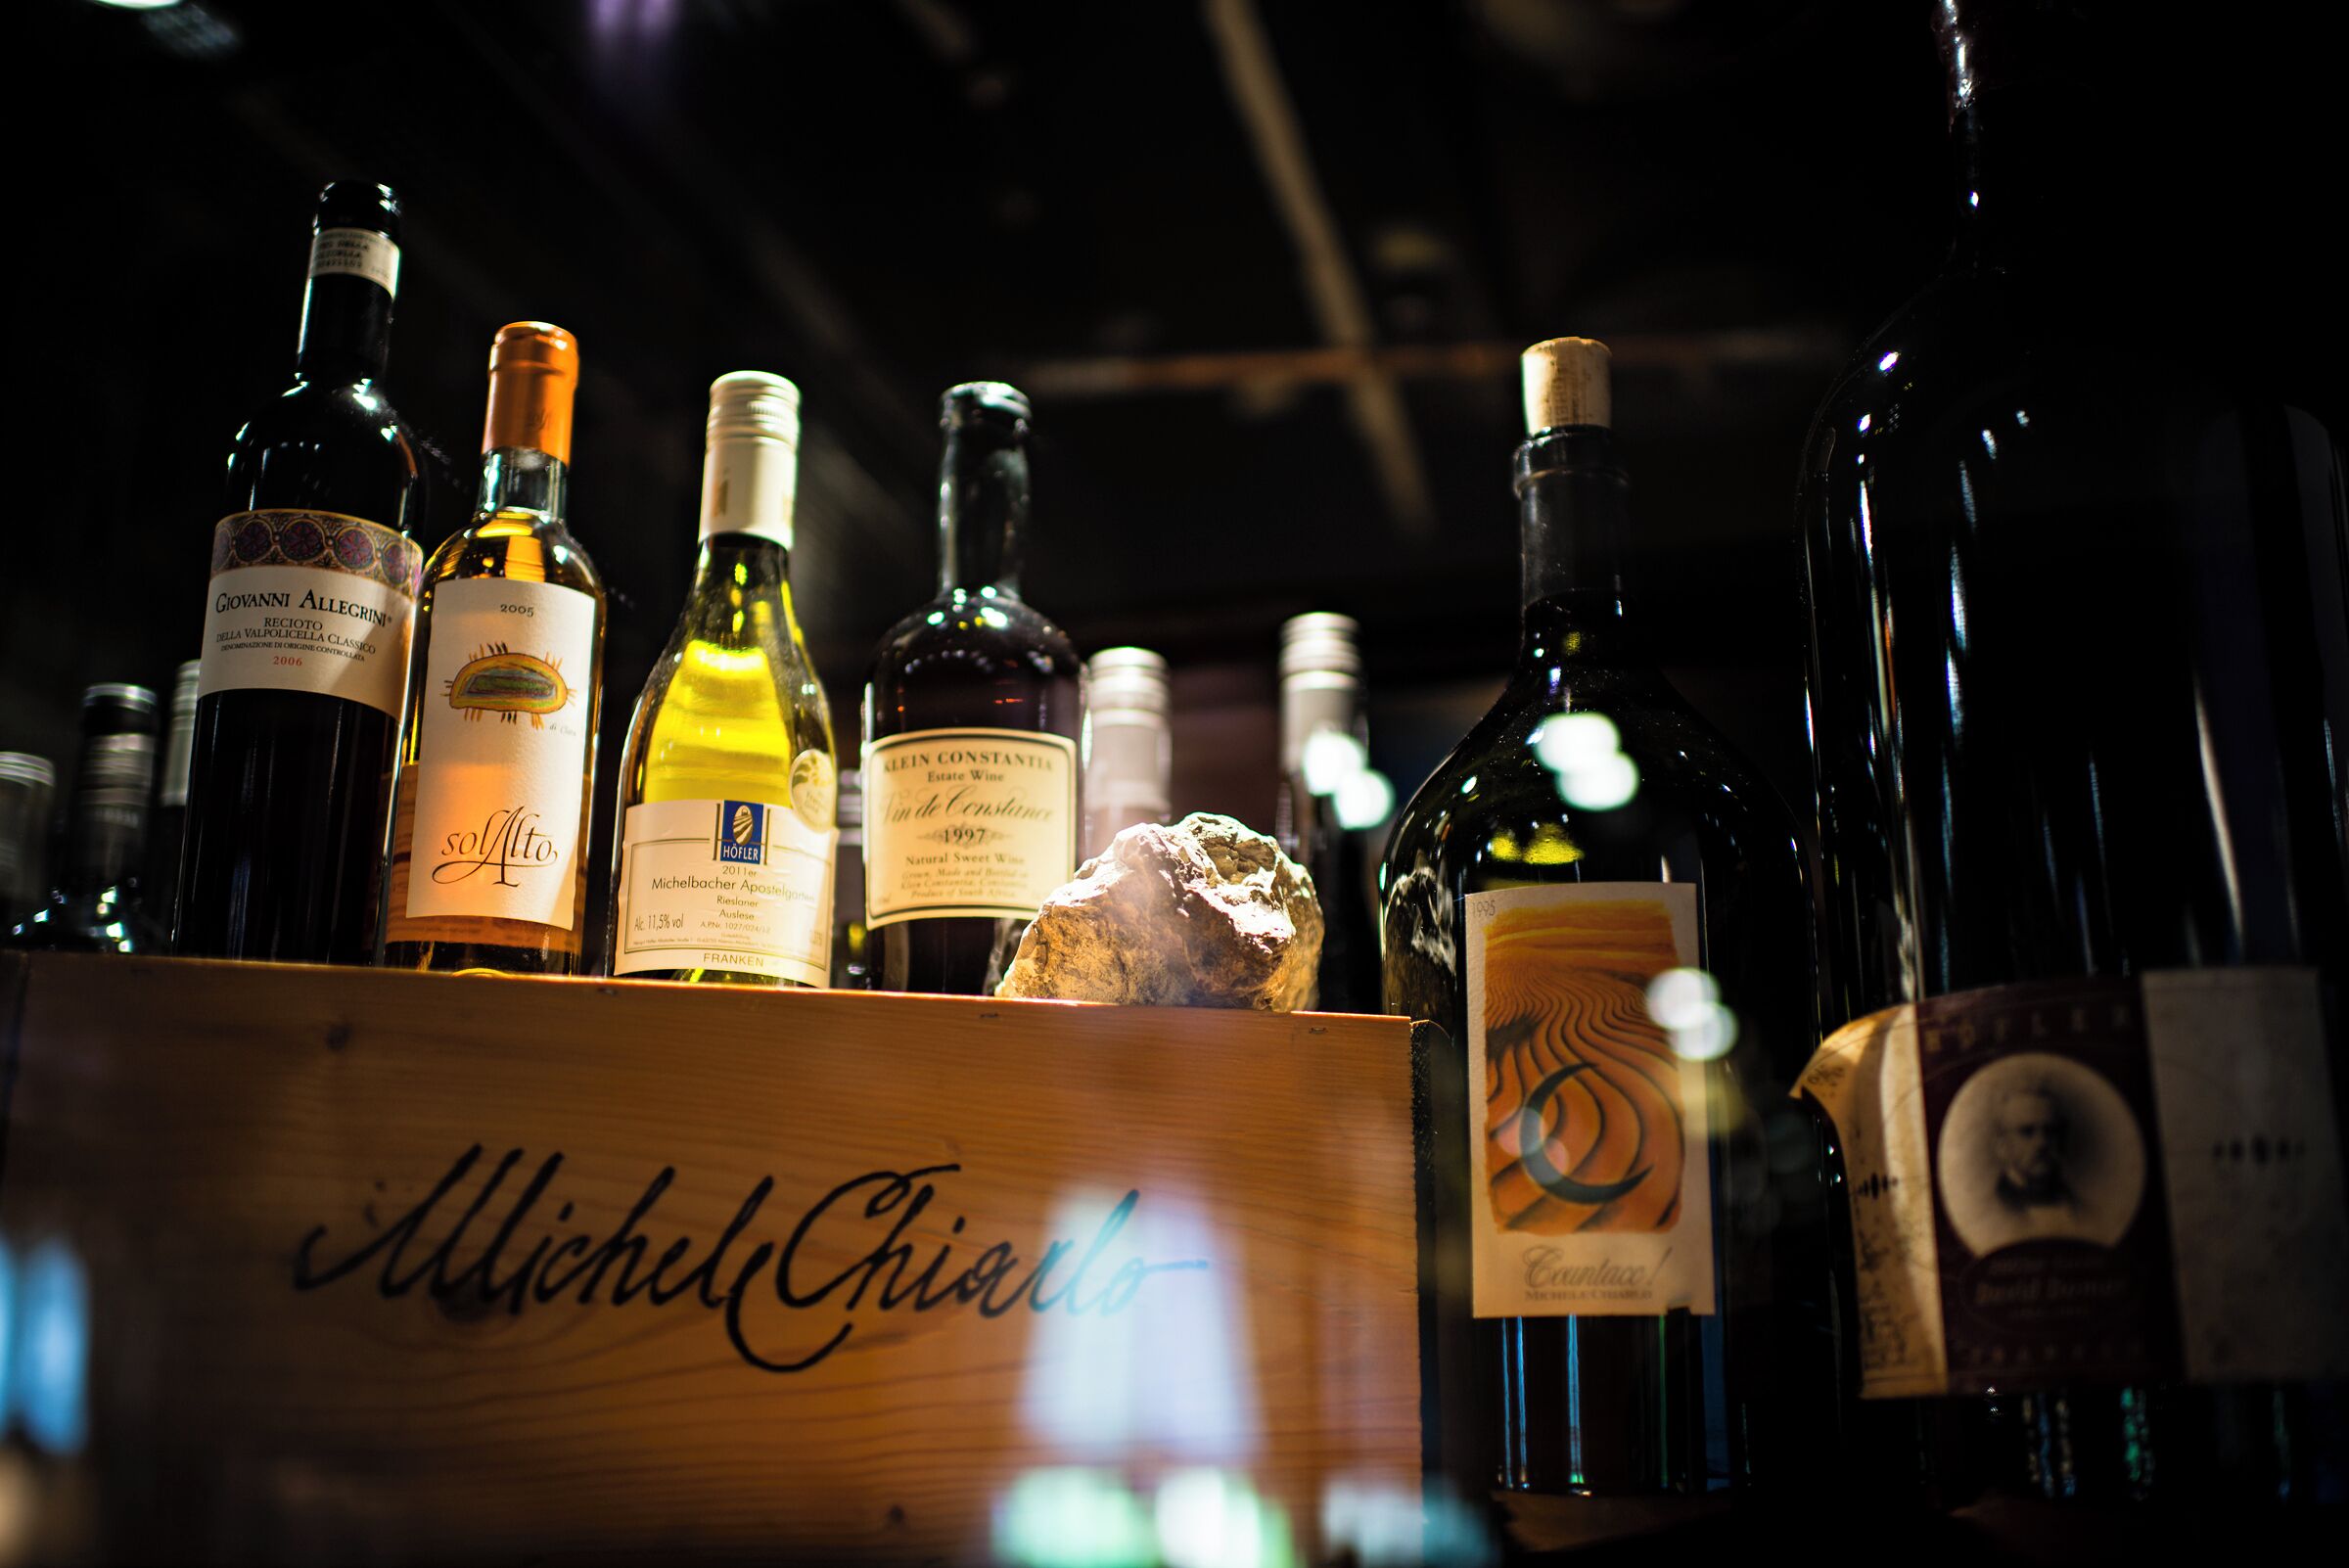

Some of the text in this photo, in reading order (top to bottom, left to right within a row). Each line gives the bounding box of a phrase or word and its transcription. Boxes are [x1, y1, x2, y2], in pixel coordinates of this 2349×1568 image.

[215, 592, 290, 614] GIOVANNI
[500, 604, 534, 618] 2005
[264, 618, 323, 631] RECIOTO
[216, 628, 376, 655] DELLA VALPOLICELLA CLASSICO
[220, 642, 273, 652] DENOMINAZIONE
[283, 642, 315, 651] ORIGINE
[316, 645, 365, 662] CONTROLLATA
[273, 656, 302, 667] 2006
[884, 751, 1053, 772] KLEIN CONSTANTIA
[927, 769, 1004, 783] Estate Wine
[943, 828, 987, 845] 1997
[722, 843, 759, 861] HÖFLER
[906, 852, 1025, 866] Natural Sweet Wine
[721, 865, 758, 878] 2011er
[651, 876, 737, 891] Michelbacher
[716, 895, 760, 908] Rieslaner
[718, 908, 756, 921] Auslese
[648, 913, 670, 932] 11,5%
[672, 913, 684, 929] vol
[703, 952, 764, 967] FRANKEN
[293, 1143, 1208, 1371] Michele Chiarlo
